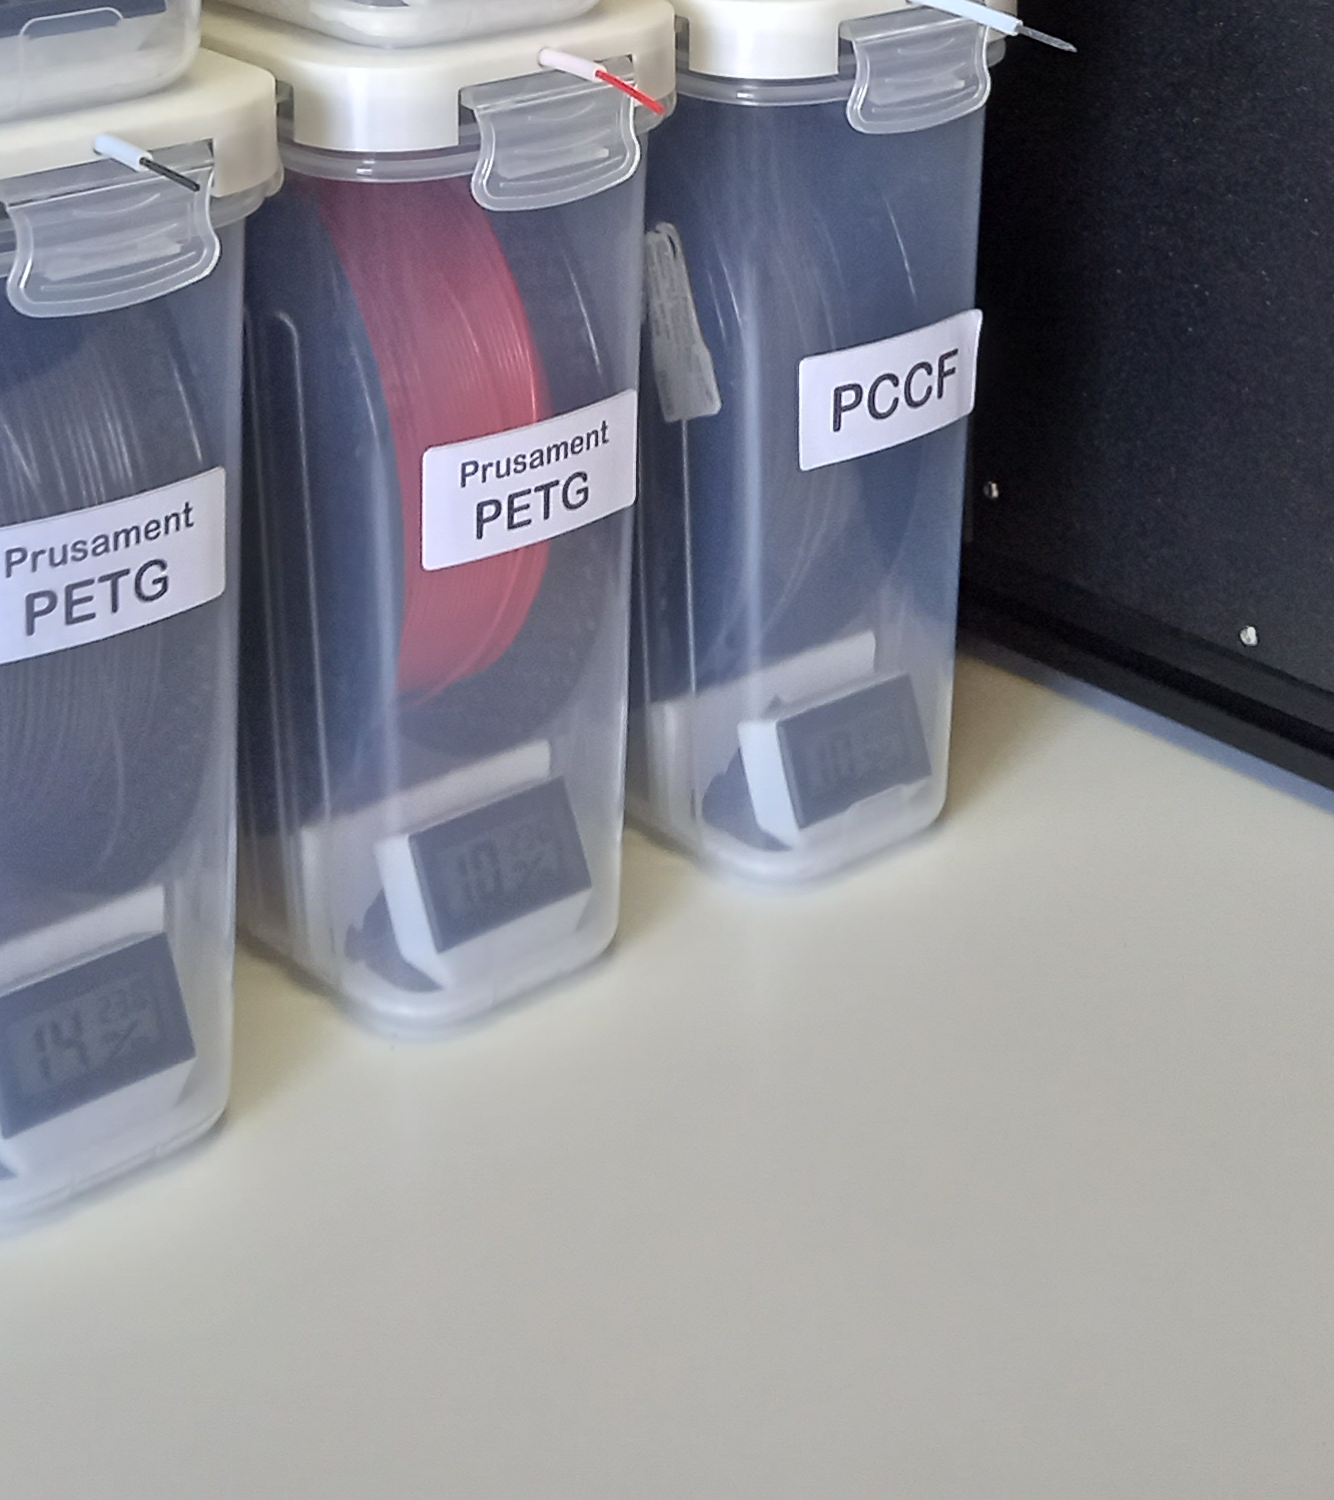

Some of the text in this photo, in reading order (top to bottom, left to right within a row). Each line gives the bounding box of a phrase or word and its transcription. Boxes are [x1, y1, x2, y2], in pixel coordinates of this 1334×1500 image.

[832, 348, 960, 433] PCCF
[460, 420, 610, 488] Prusament
[4, 501, 195, 578] Prusament
[475, 471, 589, 540] PETG
[24, 558, 170, 637] PETG
